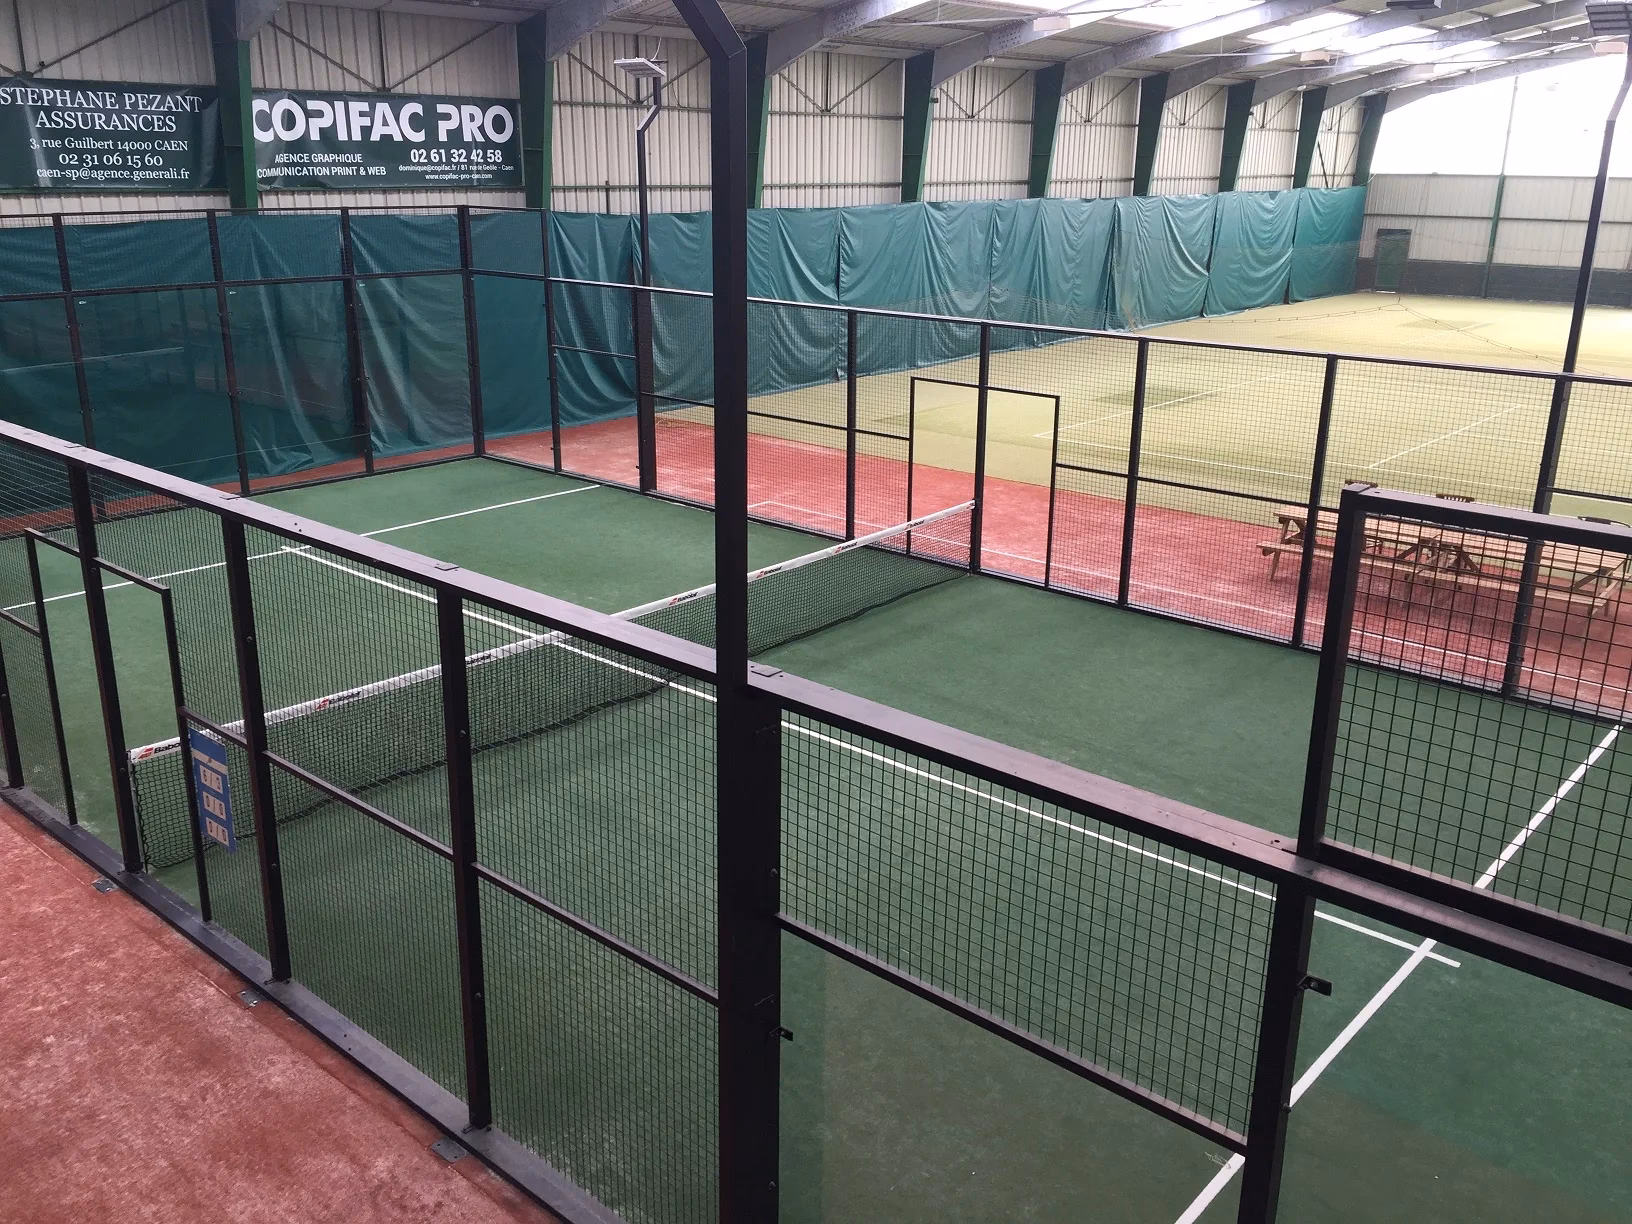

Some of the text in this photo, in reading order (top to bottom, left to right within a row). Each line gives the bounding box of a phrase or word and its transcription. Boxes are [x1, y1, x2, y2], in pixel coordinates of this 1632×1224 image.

[0, 87, 203, 113] STEPHANE PEZANT
[35, 110, 177, 132] ASSURANCES
[252, 98, 514, 144] COPIFAC PRO
[41, 139, 62, 148] rue
[64, 137, 114, 150] Guilbert
[117, 140, 152, 152] 14000
[154, 140, 188, 151] CAEN
[59, 152, 163, 168] 02 31 06 15 60
[274, 153, 363, 163] AGENCE GRAPHIQUE
[410, 149, 503, 163] 02 61 32 42 58
[36, 167, 190, 181] caen-sp@agence.generali.fr
[256, 166, 387, 178] COMMUNICATION PRINT & WEB
[153, 742, 181, 755] Babo
